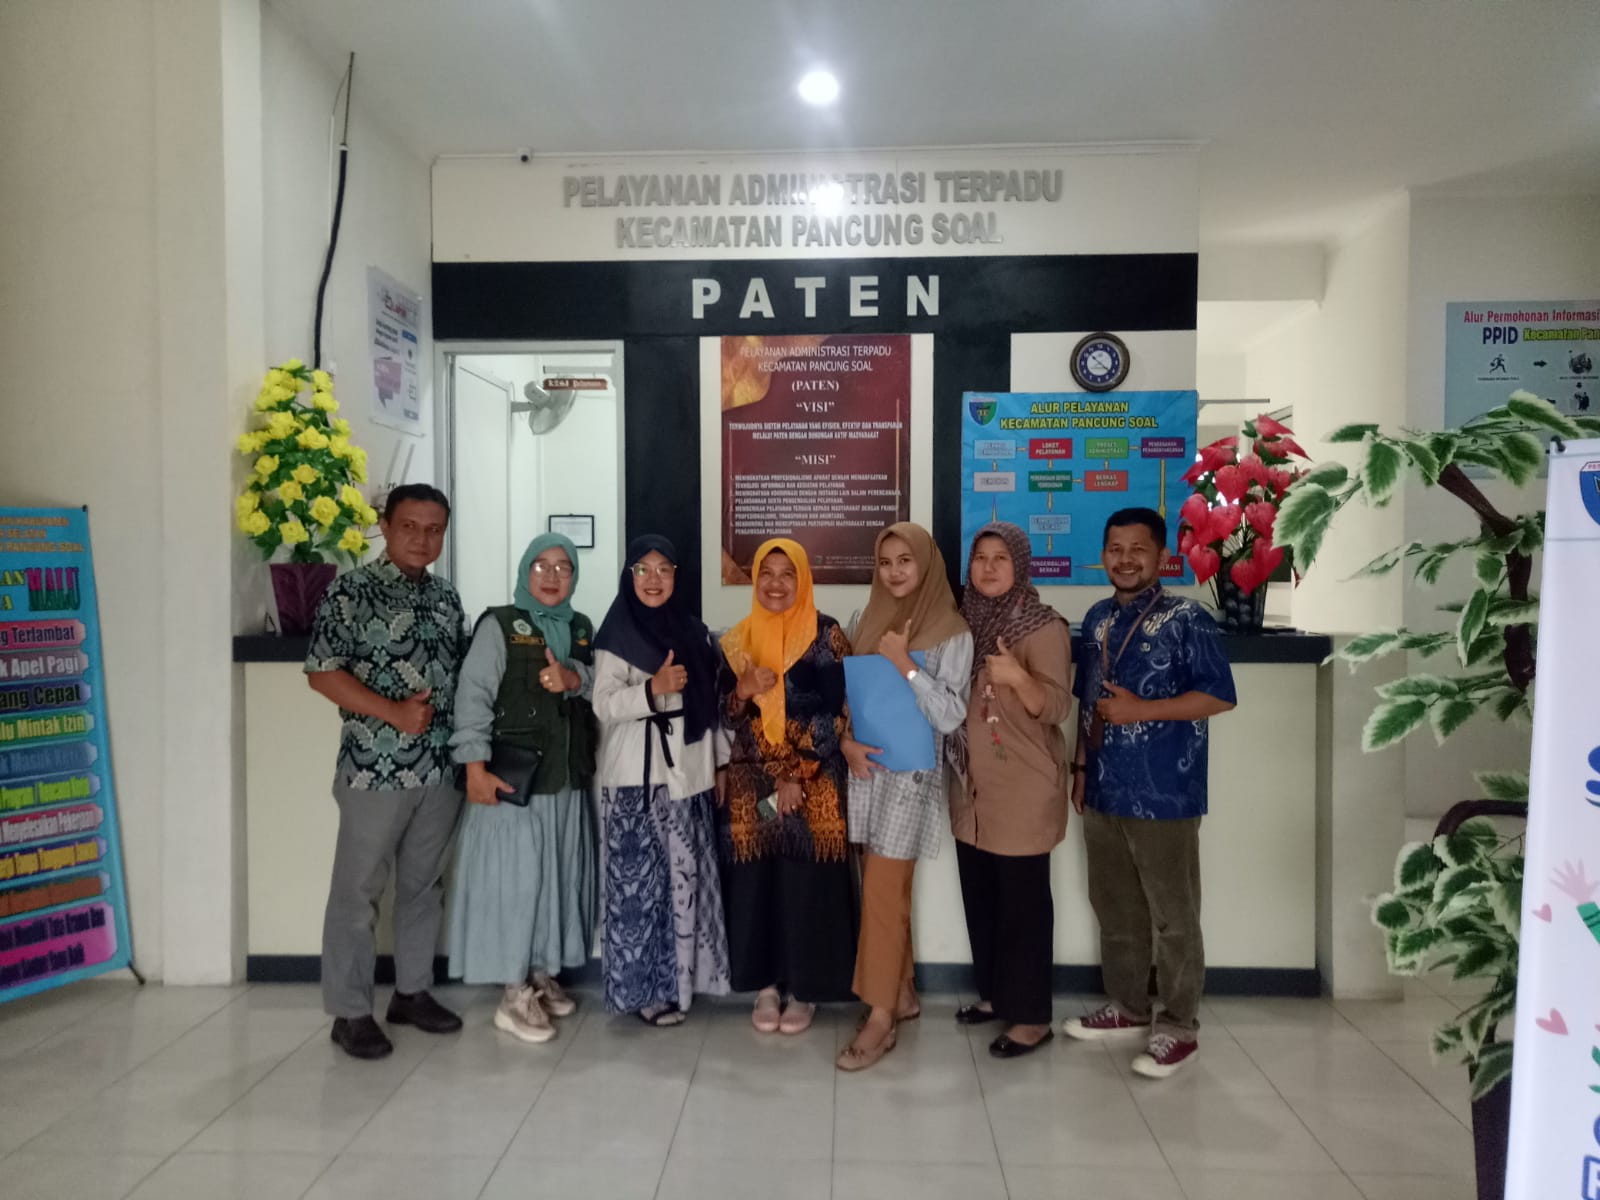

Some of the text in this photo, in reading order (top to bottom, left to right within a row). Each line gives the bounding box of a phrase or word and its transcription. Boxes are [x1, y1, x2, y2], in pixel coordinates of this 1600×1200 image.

[562, 169, 1064, 208] PELAYANAN ADMINTRASI TERPADU
[615, 211, 1004, 248] KECAMATAN PANCUNG SOAL
[692, 275, 940, 319] PATEN
[1464, 309, 1600, 323] Alur Permohonan Informasi
[1482, 326, 1518, 344] PPID
[1523, 327, 1580, 341] Kecamatan
[740, 345, 891, 357] PELAYANAN ADMINISTRASI TERPADU
[758, 360, 873, 372] KECAMATAN PANCUNG SOAL
[791, 380, 839, 392] (PATEN)
[1030, 401, 1128, 414] ALUR PELAYANAN
[1000, 416, 1158, 430] KECAMATAN PANCUNG SOAL
[12, 626, 76, 643] Terlambat
[11, 655, 45, 678] Apel
[47, 653, 79, 674] Pagi
[33, 684, 81, 705] Cepat
